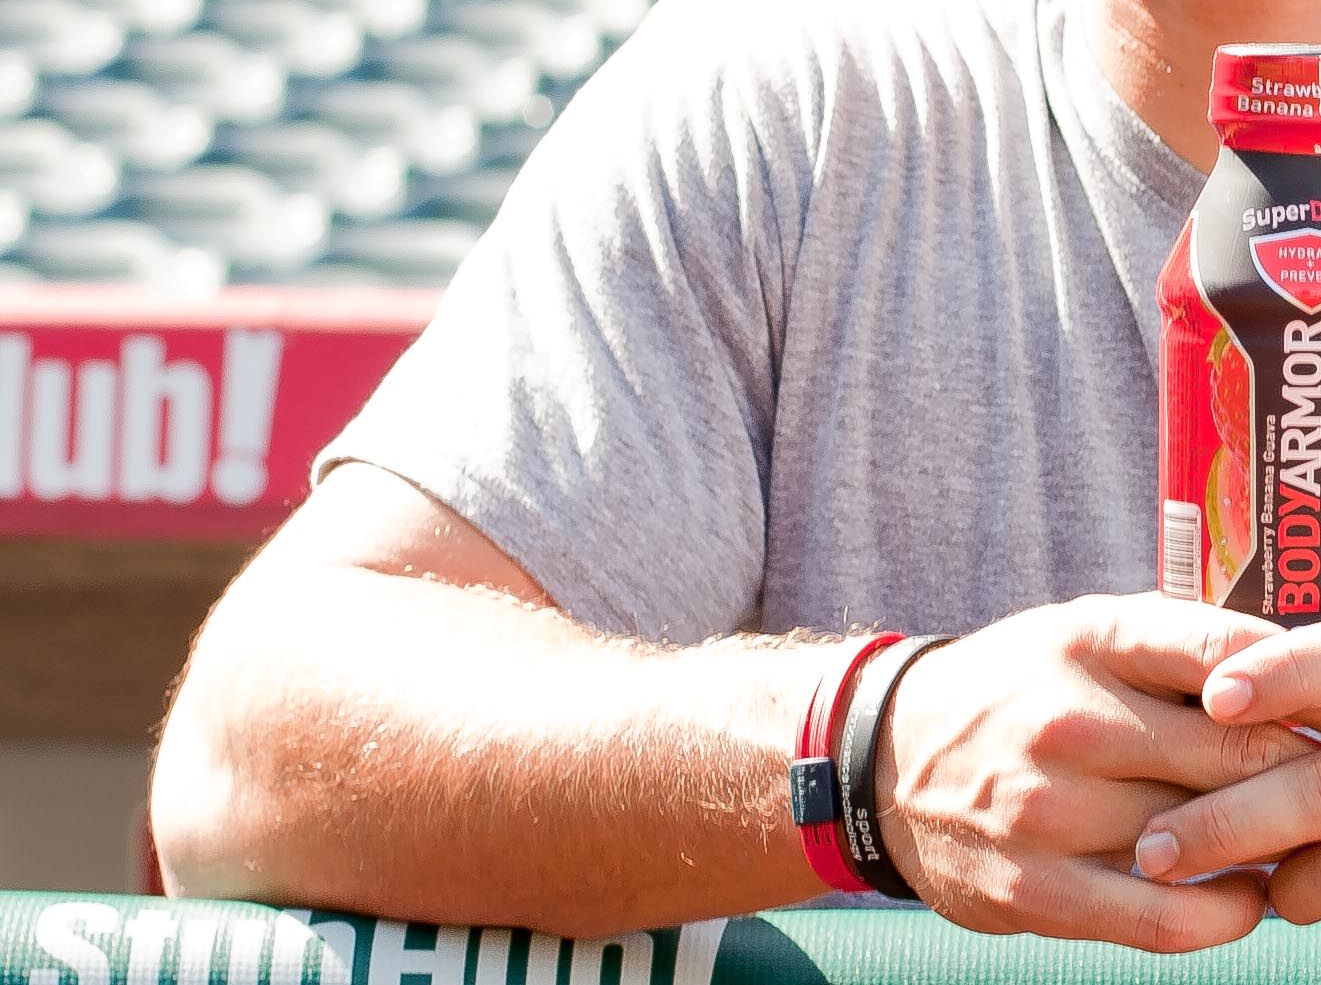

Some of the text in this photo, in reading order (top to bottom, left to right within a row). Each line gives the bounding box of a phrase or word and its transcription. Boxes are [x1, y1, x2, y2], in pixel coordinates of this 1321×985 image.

[1237, 95, 1314, 118] Banana
[1261, 414, 1276, 615] Strawberry Banana Guava
[857, 808, 880, 862] sport
